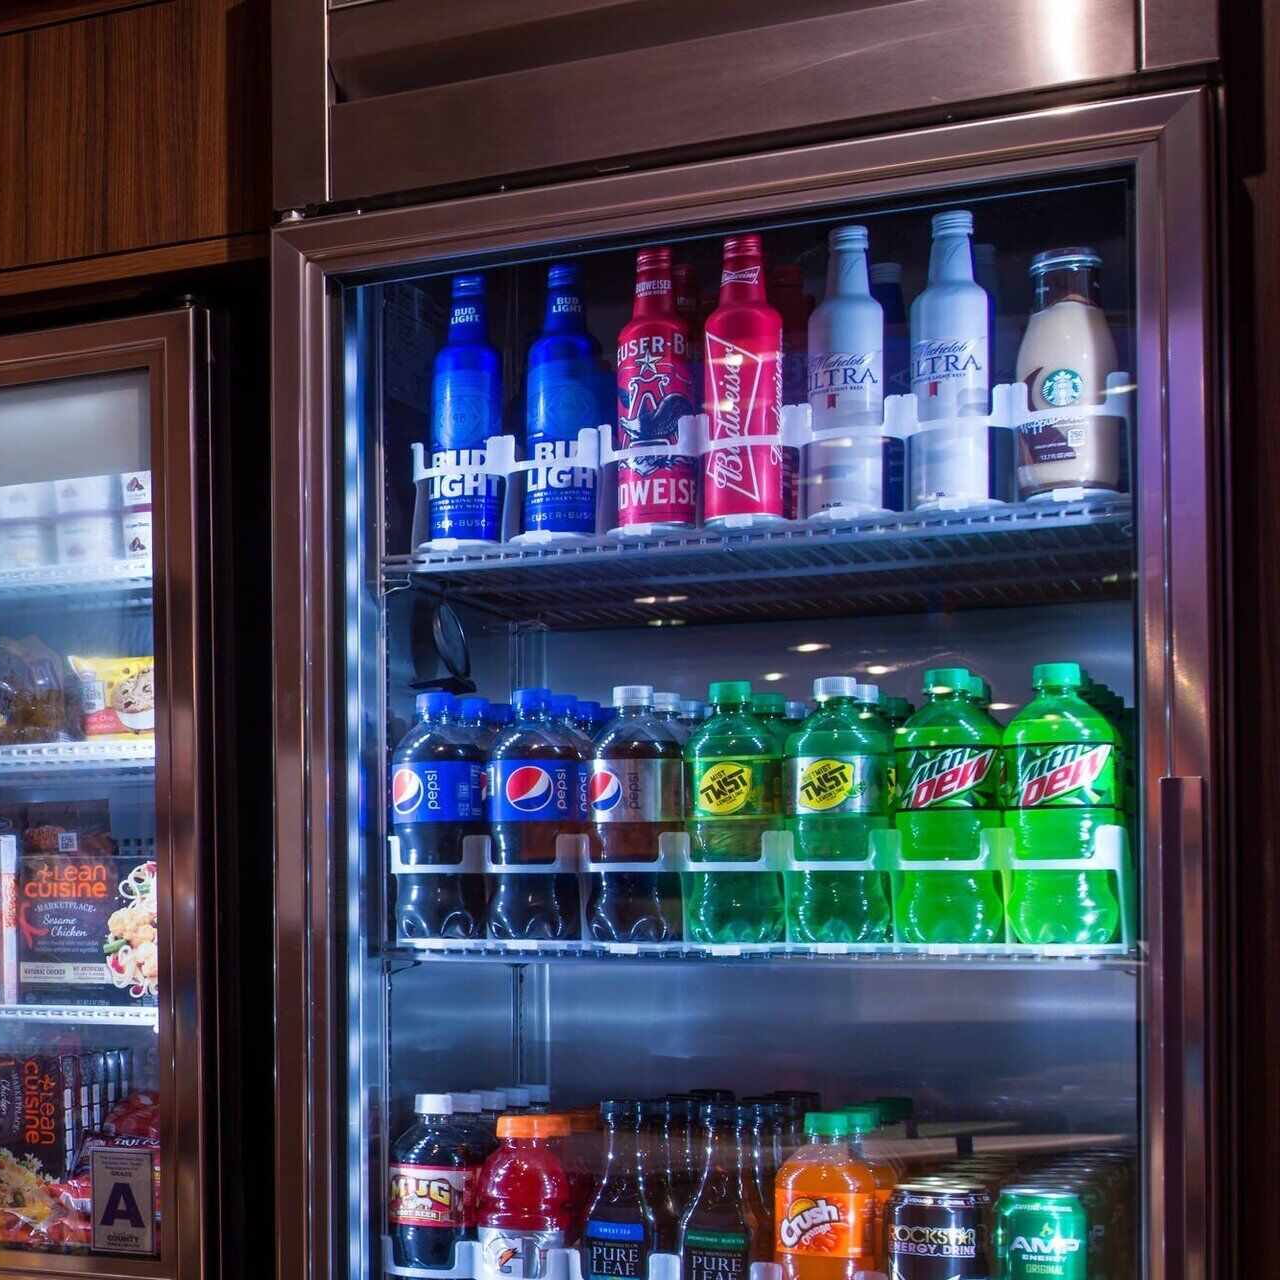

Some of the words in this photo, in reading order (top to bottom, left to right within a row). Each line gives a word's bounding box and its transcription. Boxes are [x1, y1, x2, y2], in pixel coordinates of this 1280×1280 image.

[553, 304, 582, 314] LIGHT
[557, 296, 580, 307] BUD
[451, 314, 480, 325] LIGHT
[454, 308, 476, 317] BUD
[912, 341, 968, 359] Michelob
[810, 353, 867, 372] Michelob
[706, 342, 746, 497] Budweiser
[709, 769, 726, 781] MIST
[815, 764, 832, 777] MIST
[425, 769, 441, 811] pepsi
[556, 768, 569, 811] pepsi
[627, 771, 640, 811] pepsi
[715, 796, 731, 807] LEMON
[731, 790, 744, 799] LIME
[54, 864, 107, 882] Lean
[25, 878, 107, 899] cuisine
[36, 901, 96, 914] MARKETPLACE
[42, 914, 77, 927] Sesame
[50, 925, 88, 938] Chicken
[0, 1079, 12, 1116] Chicken
[10, 1072, 22, 1134] MARKETPLACE
[23, 1058, 40, 1145] cuisine
[40, 1086, 57, 1146] Lean
[390, 1177, 450, 1206] MUG
[99, 1182, 146, 1229] A
[415, 1210, 438, 1219] BEER
[598, 1227, 619, 1235] SWEET
[781, 1199, 841, 1248] Crush
[801, 1222, 832, 1247] Orange
[890, 1227, 976, 1247] ROCKSTAR
[890, 1243, 938, 1256] ENERGY
[943, 1245, 976, 1257] DRINK
[1010, 1237, 1080, 1253] AMP
[592, 1246, 639, 1262] PURE
[1021, 1254, 1067, 1263] ENERGY
[691, 1255, 742, 1272] PURE
[1025, 1263, 1064, 1276] ORIGINAL
